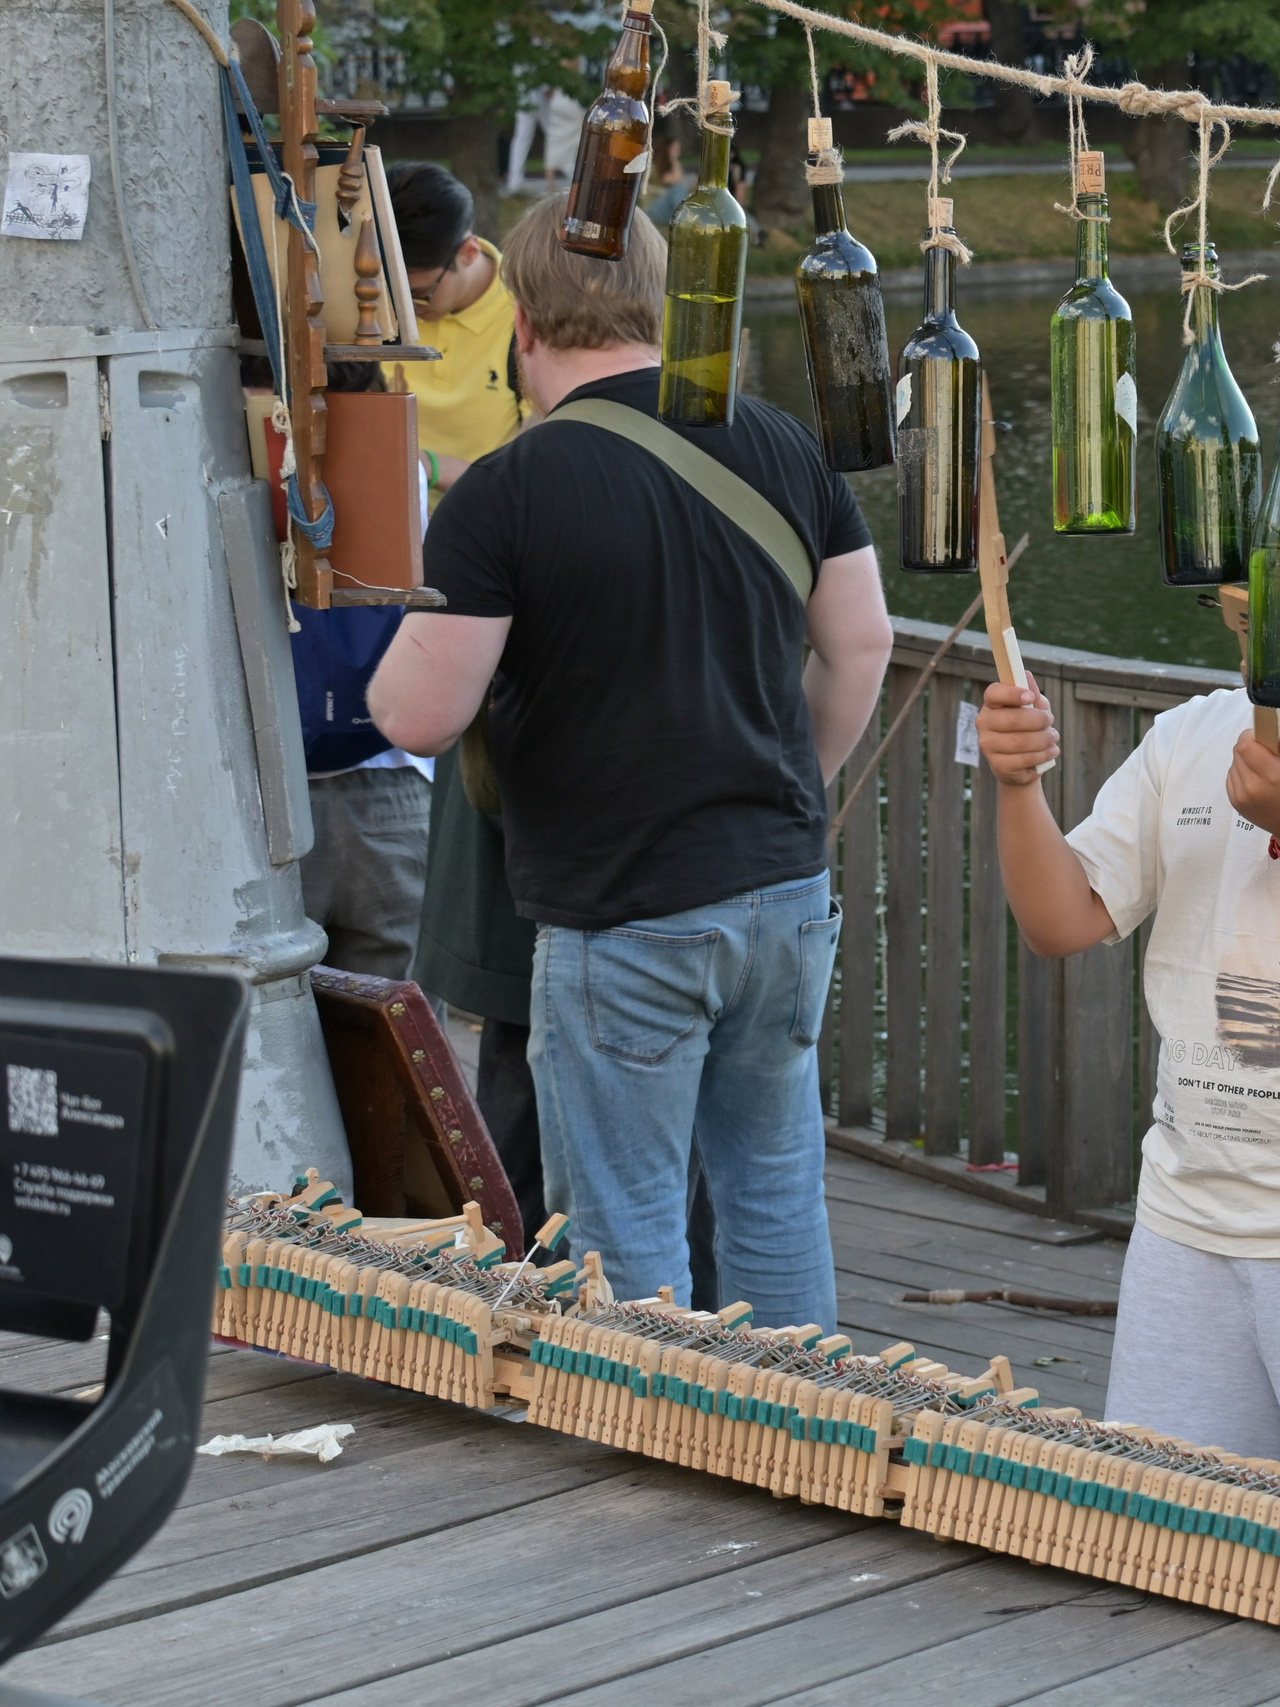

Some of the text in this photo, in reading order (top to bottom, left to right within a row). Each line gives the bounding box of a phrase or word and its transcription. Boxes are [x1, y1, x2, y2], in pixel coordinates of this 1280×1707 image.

[1181, 806, 1212, 815] MINDSET IS
[1176, 817, 1211, 826] EVERYTHING
[1236, 819, 1255, 832] STOP
[1191, 1042, 1242, 1072] DAY
[1178, 1077, 1201, 1088] DON'T
[1203, 1081, 1215, 1090] LET
[1217, 1083, 1244, 1096] OTHER
